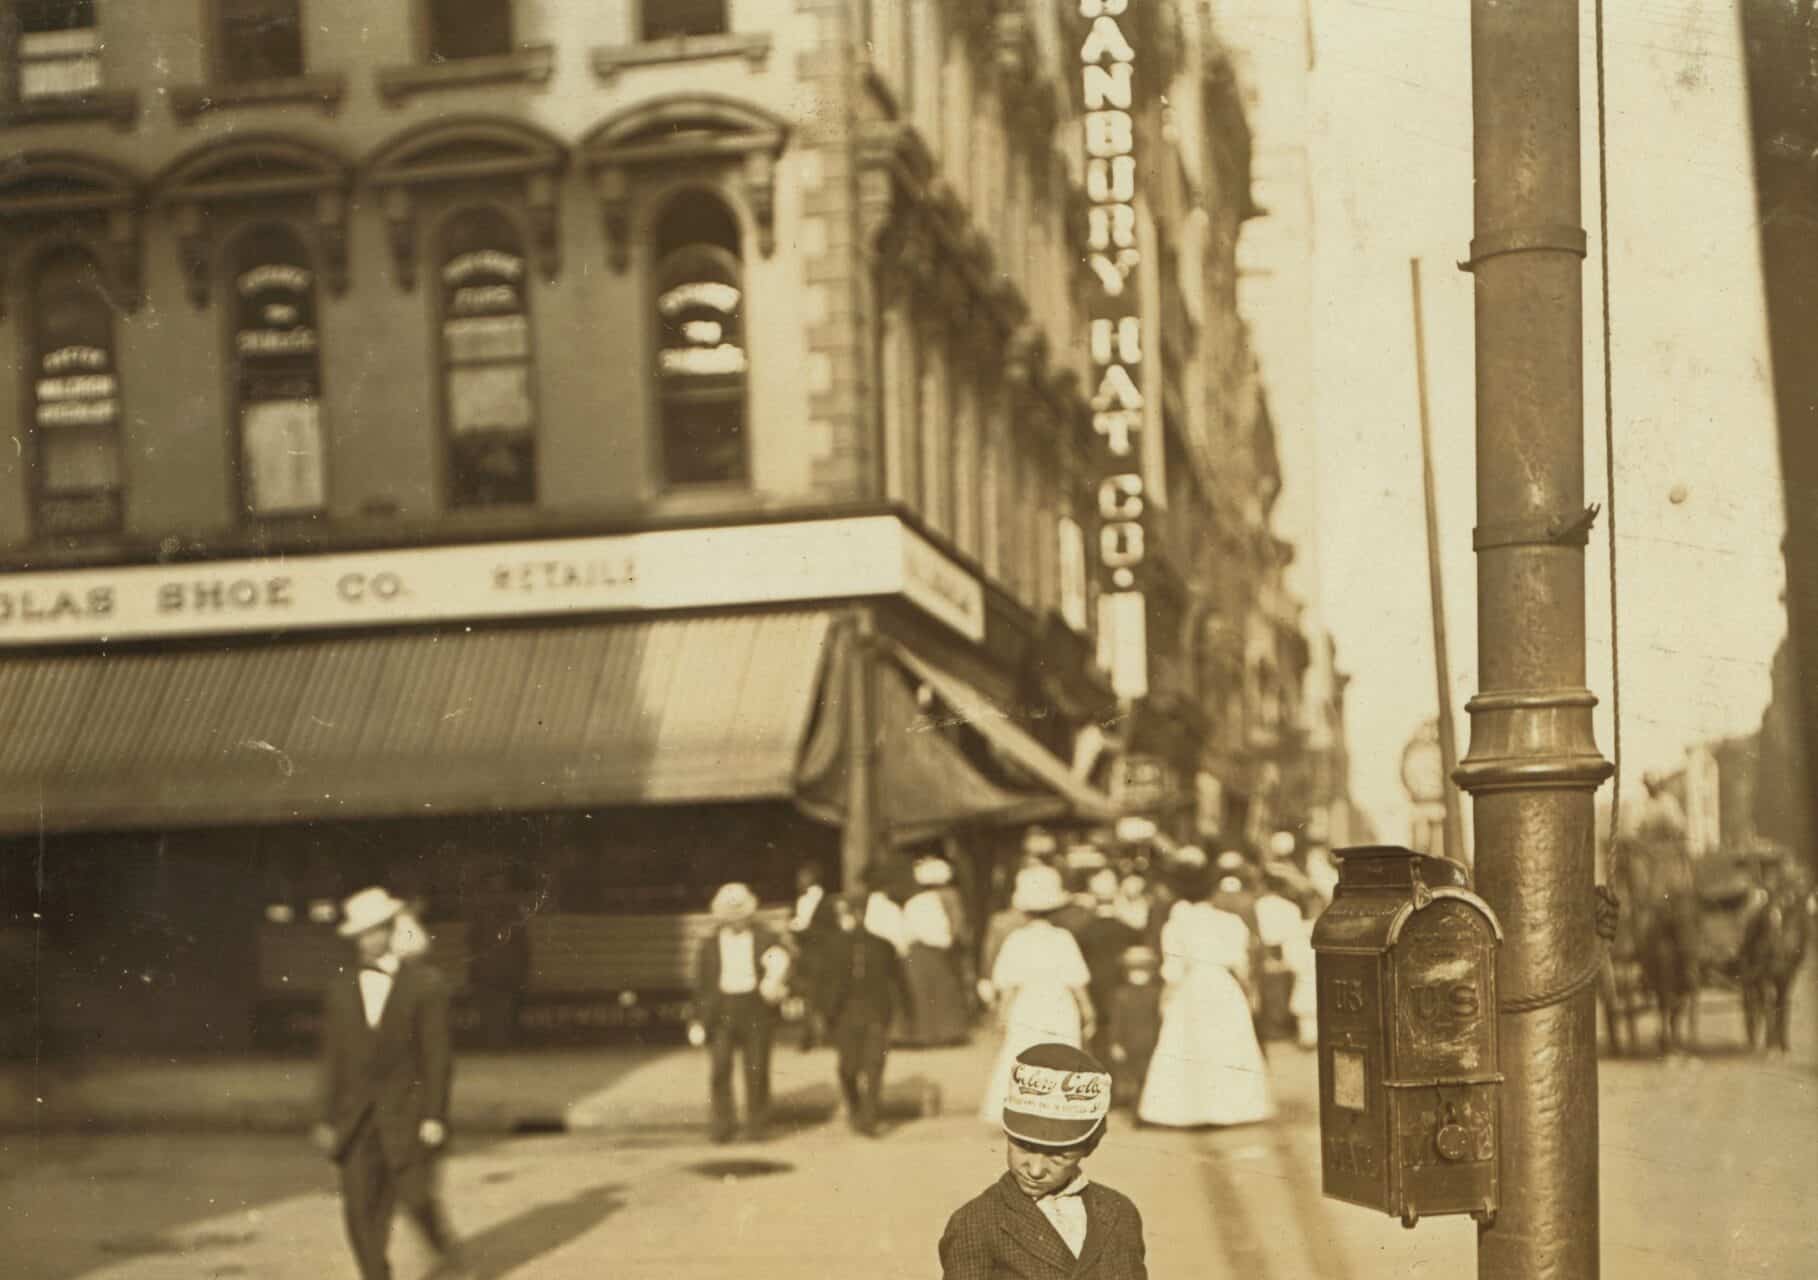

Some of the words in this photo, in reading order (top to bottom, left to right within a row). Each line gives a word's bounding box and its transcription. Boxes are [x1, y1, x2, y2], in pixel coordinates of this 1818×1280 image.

[1091, 315, 1144, 456] HAT
[1098, 473, 1145, 587] CO.
[157, 576, 293, 613] SHOE
